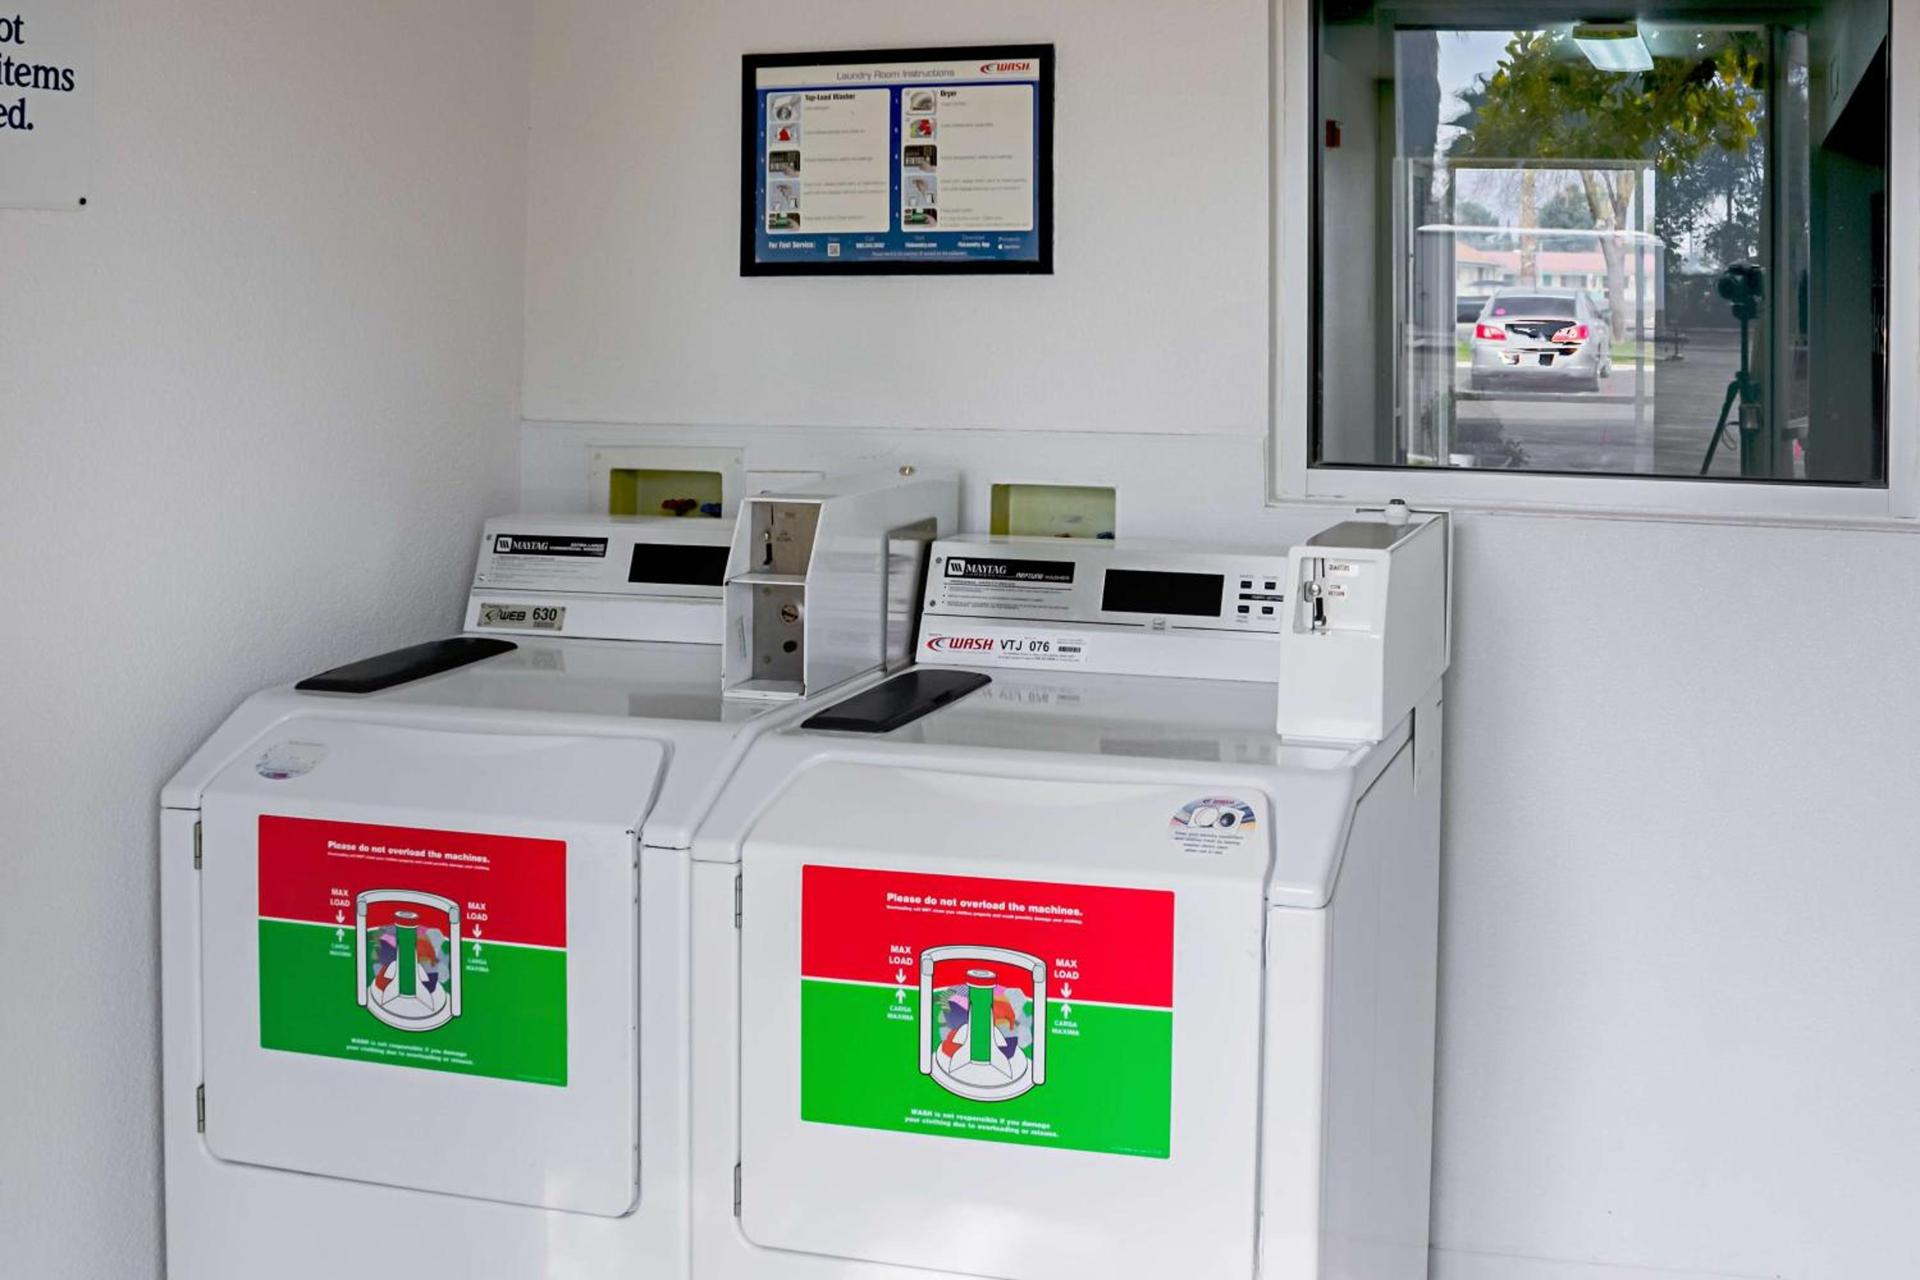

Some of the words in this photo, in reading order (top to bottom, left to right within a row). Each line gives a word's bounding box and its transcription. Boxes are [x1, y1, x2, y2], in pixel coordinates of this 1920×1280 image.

[836, 70, 872, 81] Laundry
[874, 70, 899, 79] Room
[902, 69, 955, 79] Instructions
[832, 93, 856, 101] Washer
[940, 90, 957, 98] Dryer
[511, 541, 549, 551] MAYTAG
[965, 563, 1007, 575] MAYTAG
[499, 611, 526, 621] WEB
[532, 607, 557, 621] 630
[948, 638, 994, 650] WASH
[999, 639, 1023, 651] VTJ
[1029, 640, 1050, 652] 076
[327, 841, 356, 851] Please
[358, 844, 369, 852] do
[371, 846, 385, 854] not
[388, 848, 425, 858] overload
[428, 850, 442, 859] the
[444, 853, 490, 864] machines.
[330, 888, 348, 897] MAX
[329, 899, 350, 908] LOAD
[467, 902, 486, 911] MAX
[886, 892, 922, 904] Please
[924, 896, 938, 905] do
[940, 898, 958, 907] not
[960, 900, 1005, 911] overload
[1008, 902, 1026, 912] the
[1028, 904, 1084, 917] machines.
[466, 912, 487, 922] LOAD
[890, 945, 912, 954] MAX
[888, 956, 914, 966] LOAD
[1056, 959, 1077, 968] MAX
[1054, 970, 1080, 980] LOAD
